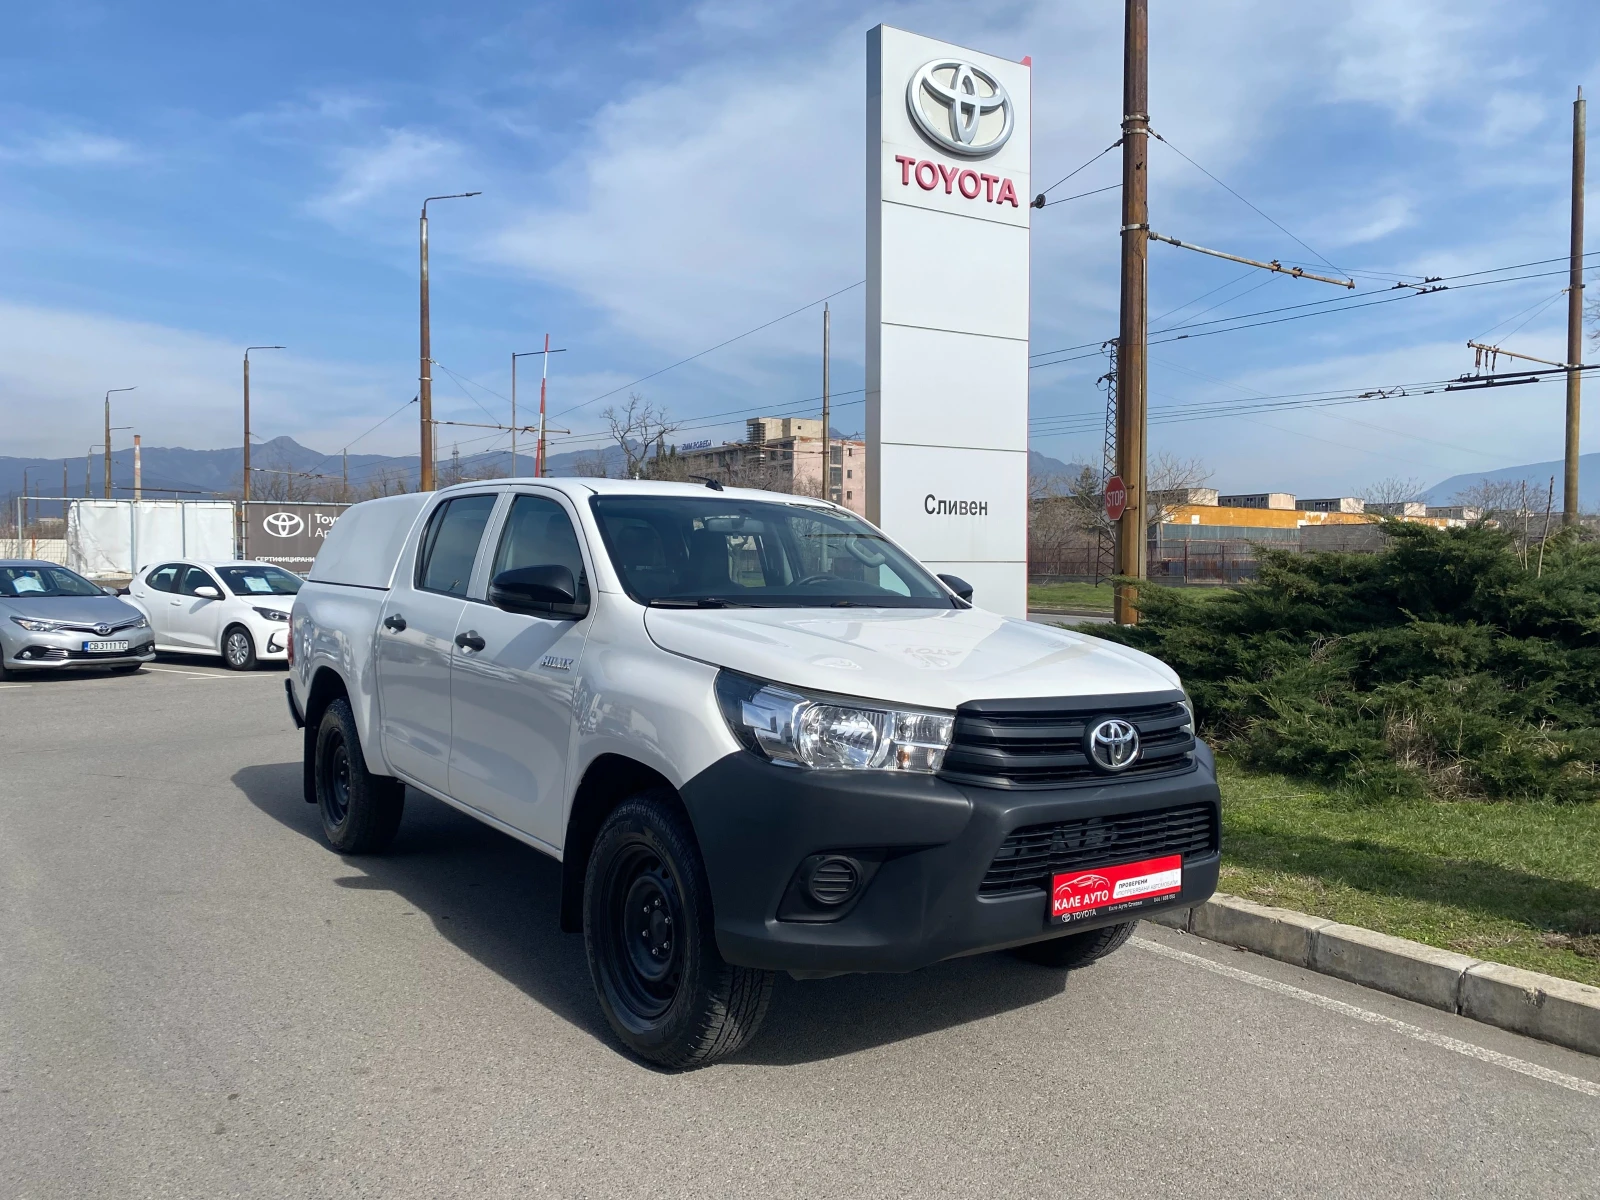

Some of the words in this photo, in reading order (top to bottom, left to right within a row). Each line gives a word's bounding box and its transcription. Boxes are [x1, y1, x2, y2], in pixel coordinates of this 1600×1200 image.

[895, 154, 1019, 208] TOYOTA
[924, 493, 988, 516] Сливен
[1106, 490, 1124, 507] STOP
[89, 642, 99, 650] CB
[99, 642, 117, 650] 3111
[117, 641, 127, 649] TC
[541, 655, 575, 671] HILUX
[1118, 878, 1148, 889] ПРОВЕРЕНИ
[1054, 895, 1081, 911] КАЛЕ
[1083, 889, 1109, 905] АУТО
[1072, 908, 1097, 921] TOYOTA
